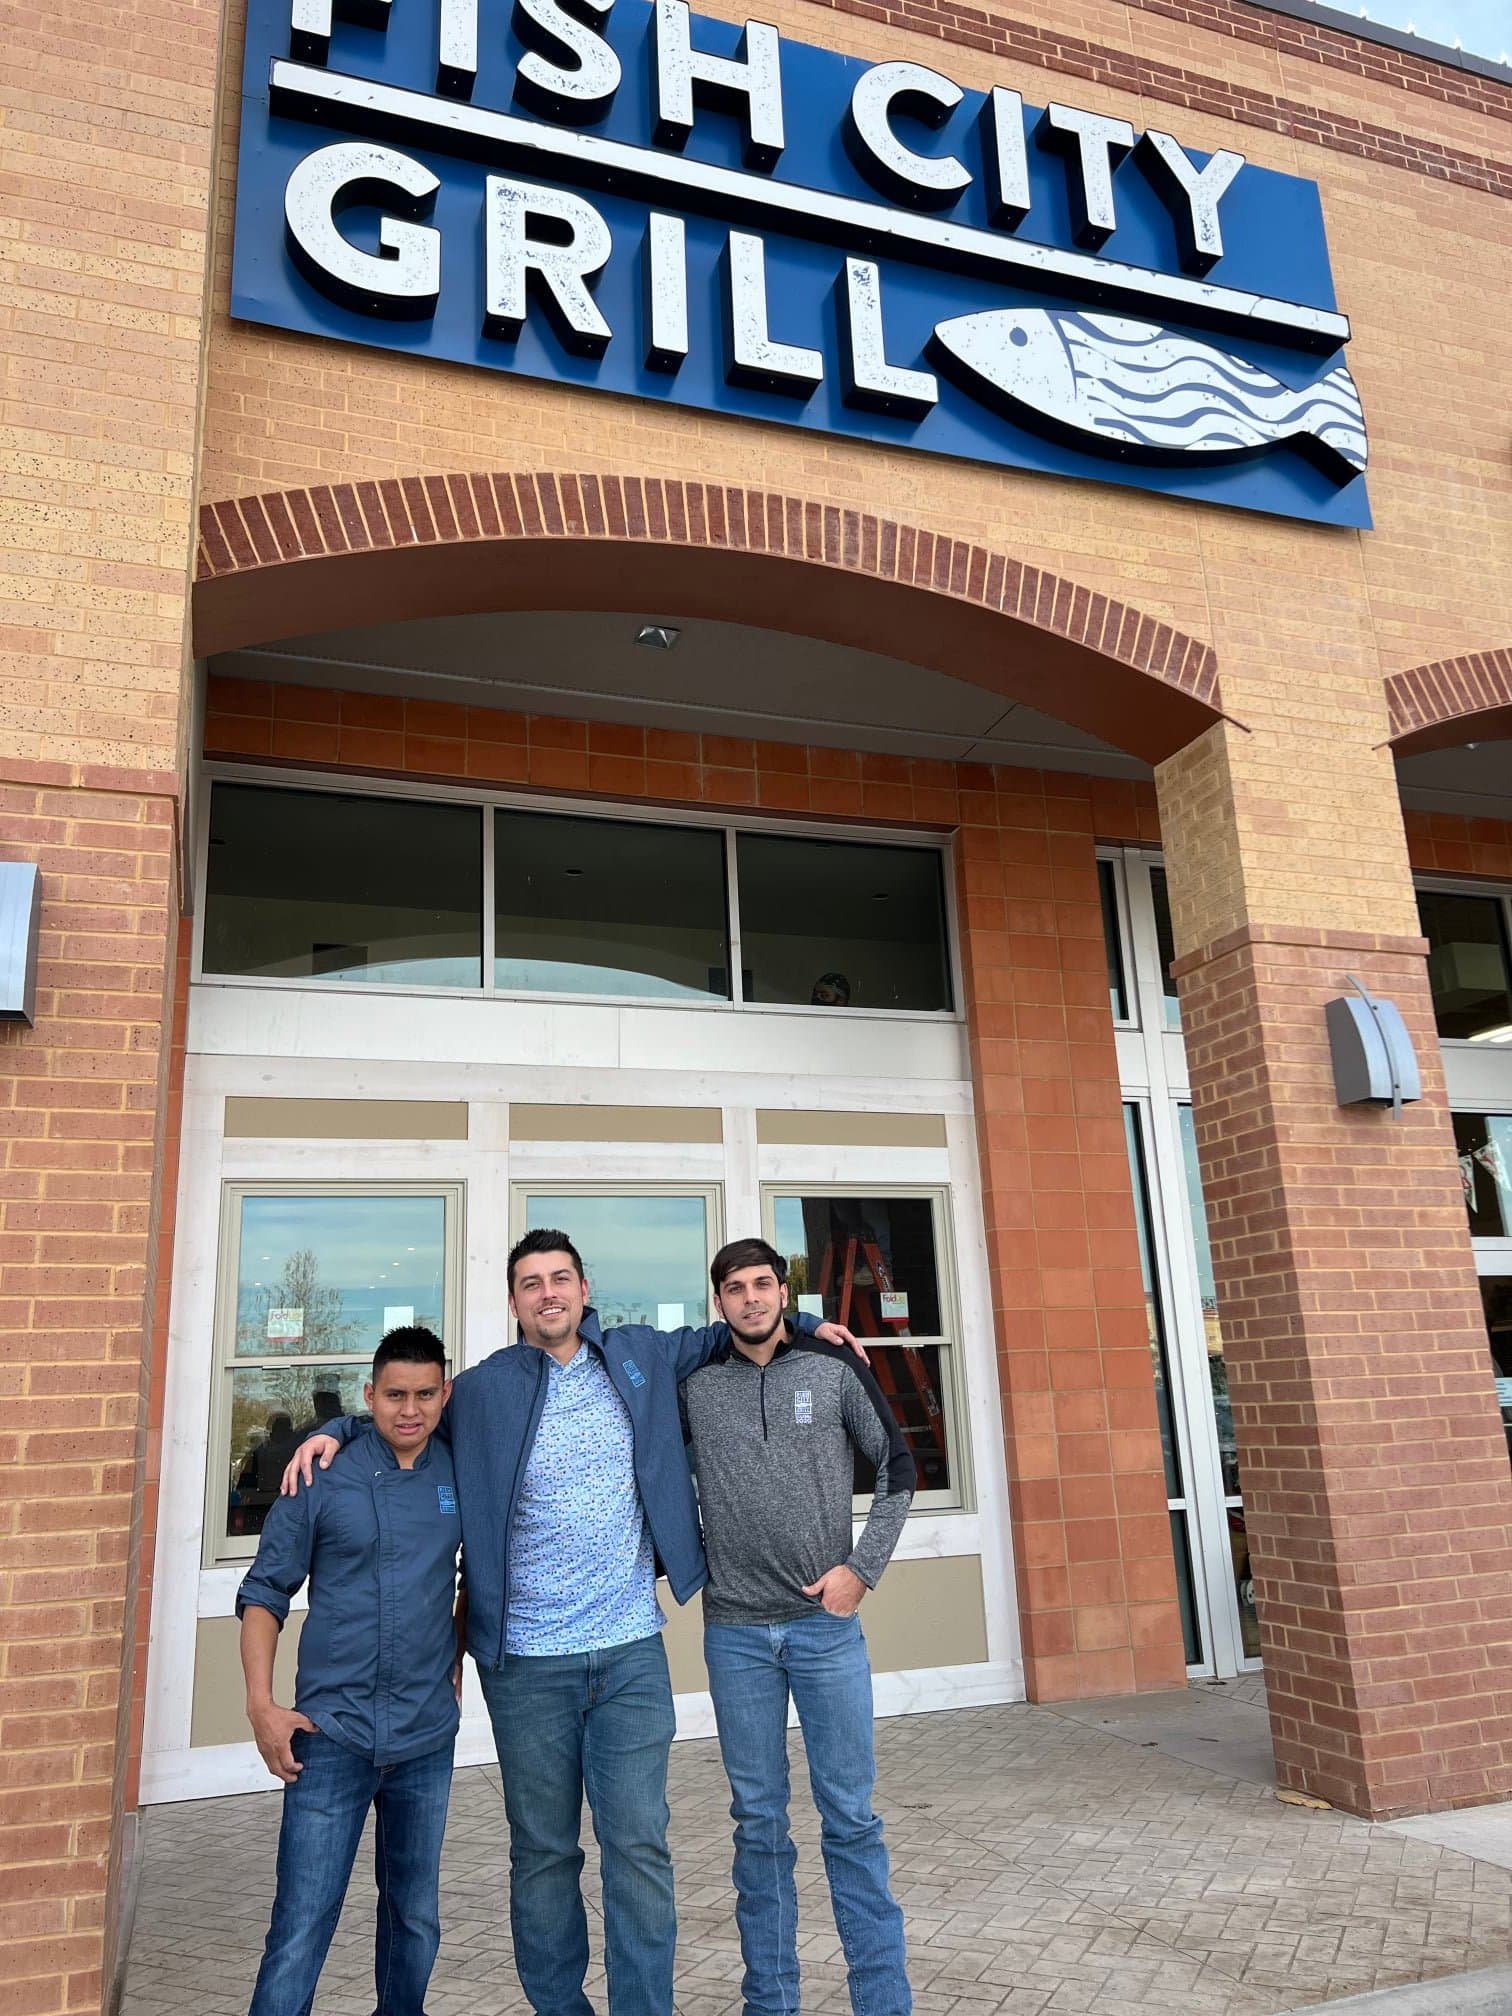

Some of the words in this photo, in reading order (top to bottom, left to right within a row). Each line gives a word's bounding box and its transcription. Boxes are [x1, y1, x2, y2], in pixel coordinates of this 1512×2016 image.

[291, 0, 785, 150] ISH
[851, 60, 1246, 257] CITY
[284, 141, 939, 404] GRILL
